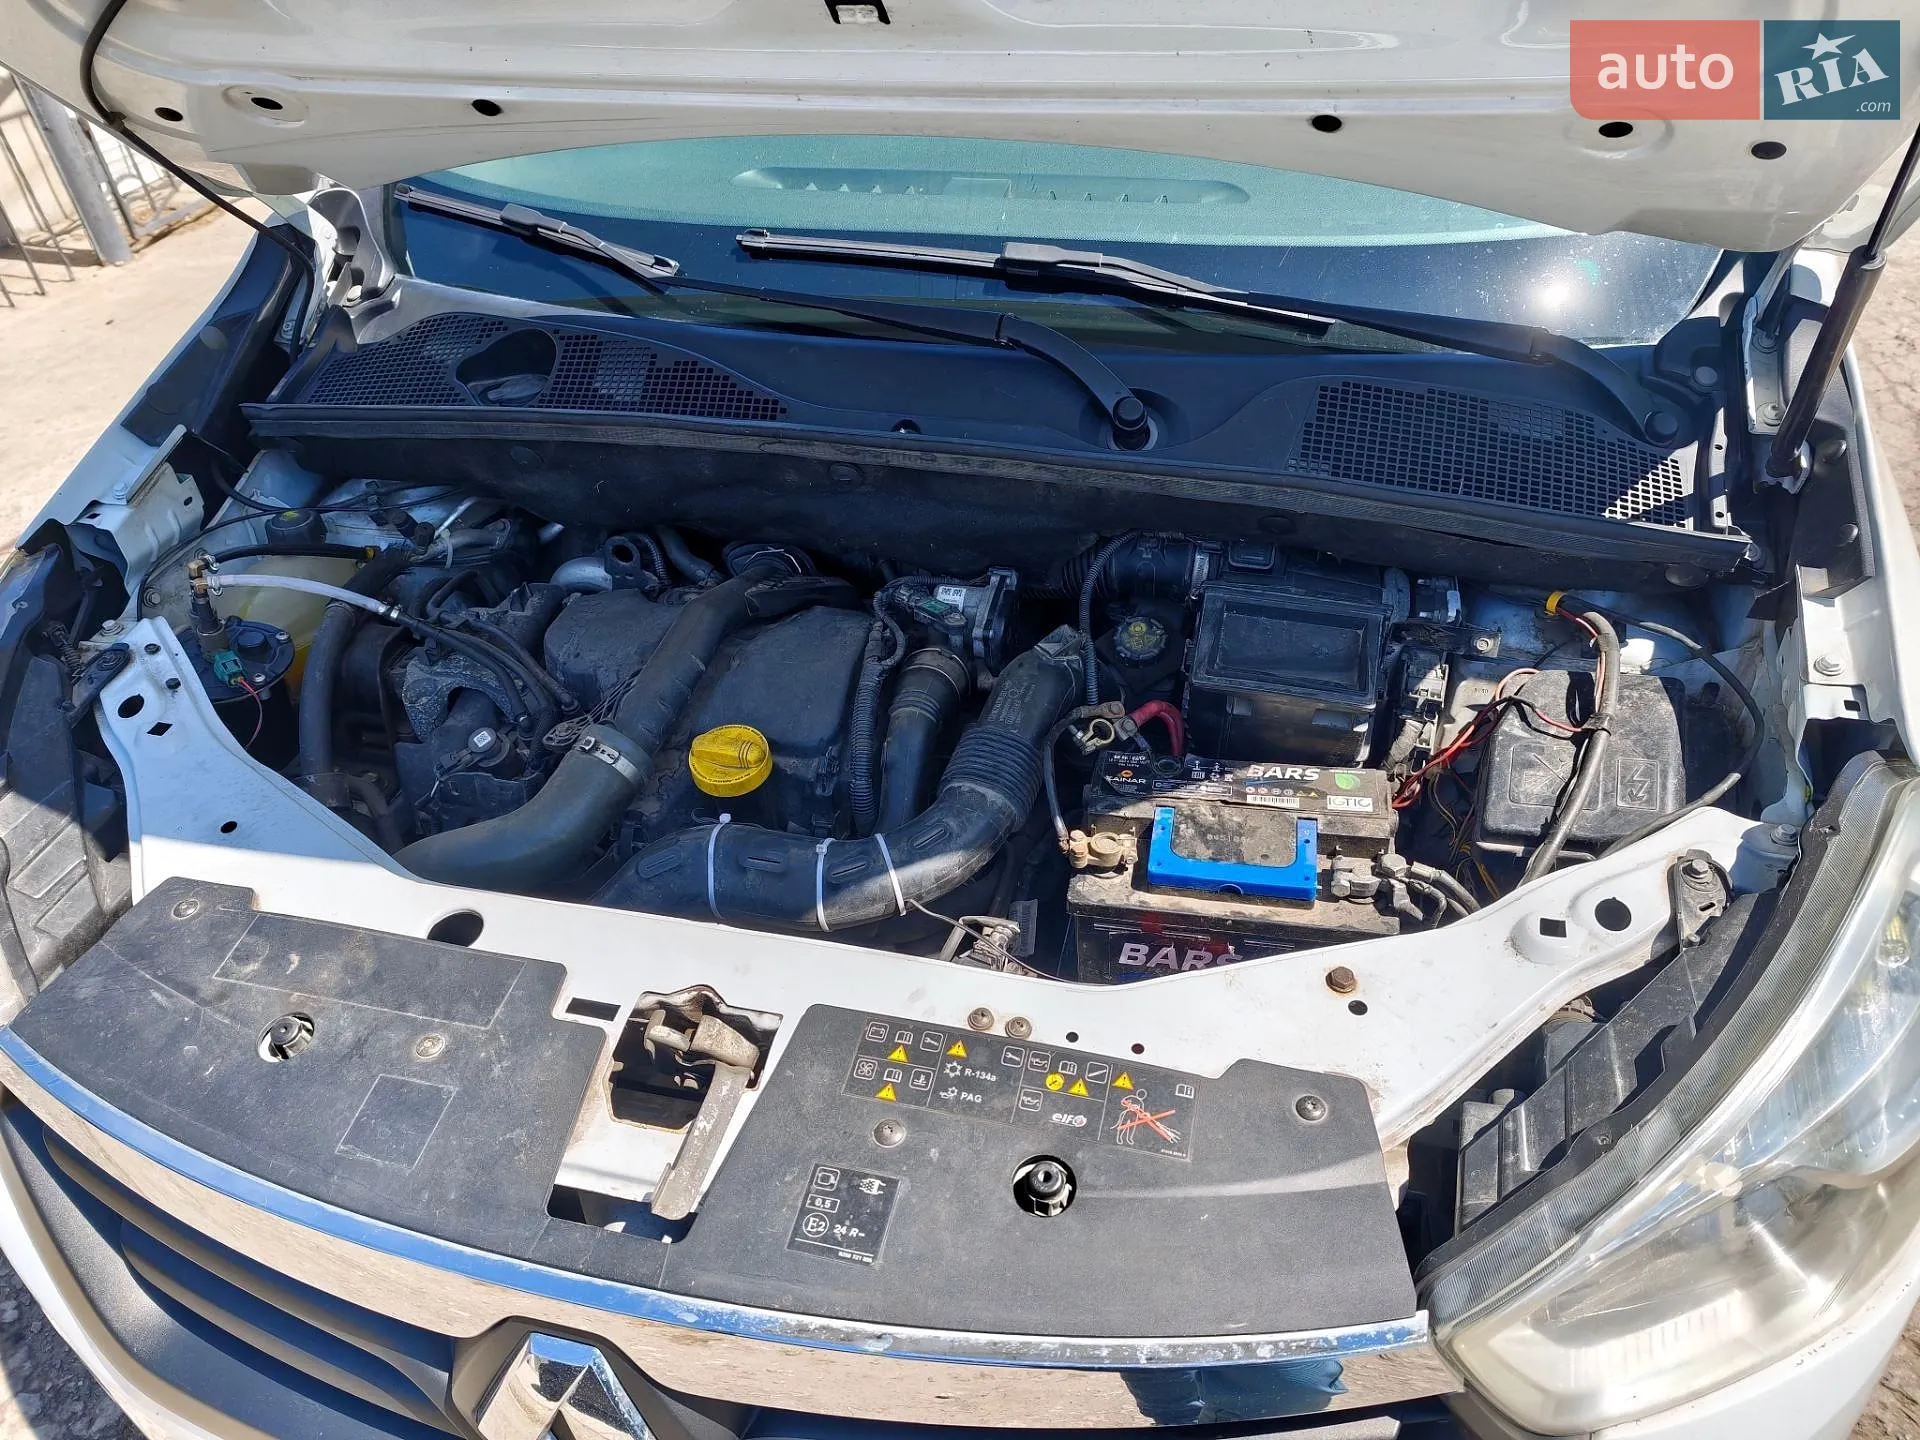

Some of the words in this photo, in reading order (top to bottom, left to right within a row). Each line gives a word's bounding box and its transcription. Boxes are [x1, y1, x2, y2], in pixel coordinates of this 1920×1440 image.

[1247, 764, 1321, 781] BARS
[964, 1068, 997, 1082] R-134a
[960, 1091, 982, 1103] PAG
[1051, 1112, 1075, 1124] elf
[833, 1224, 847, 1235] 24
